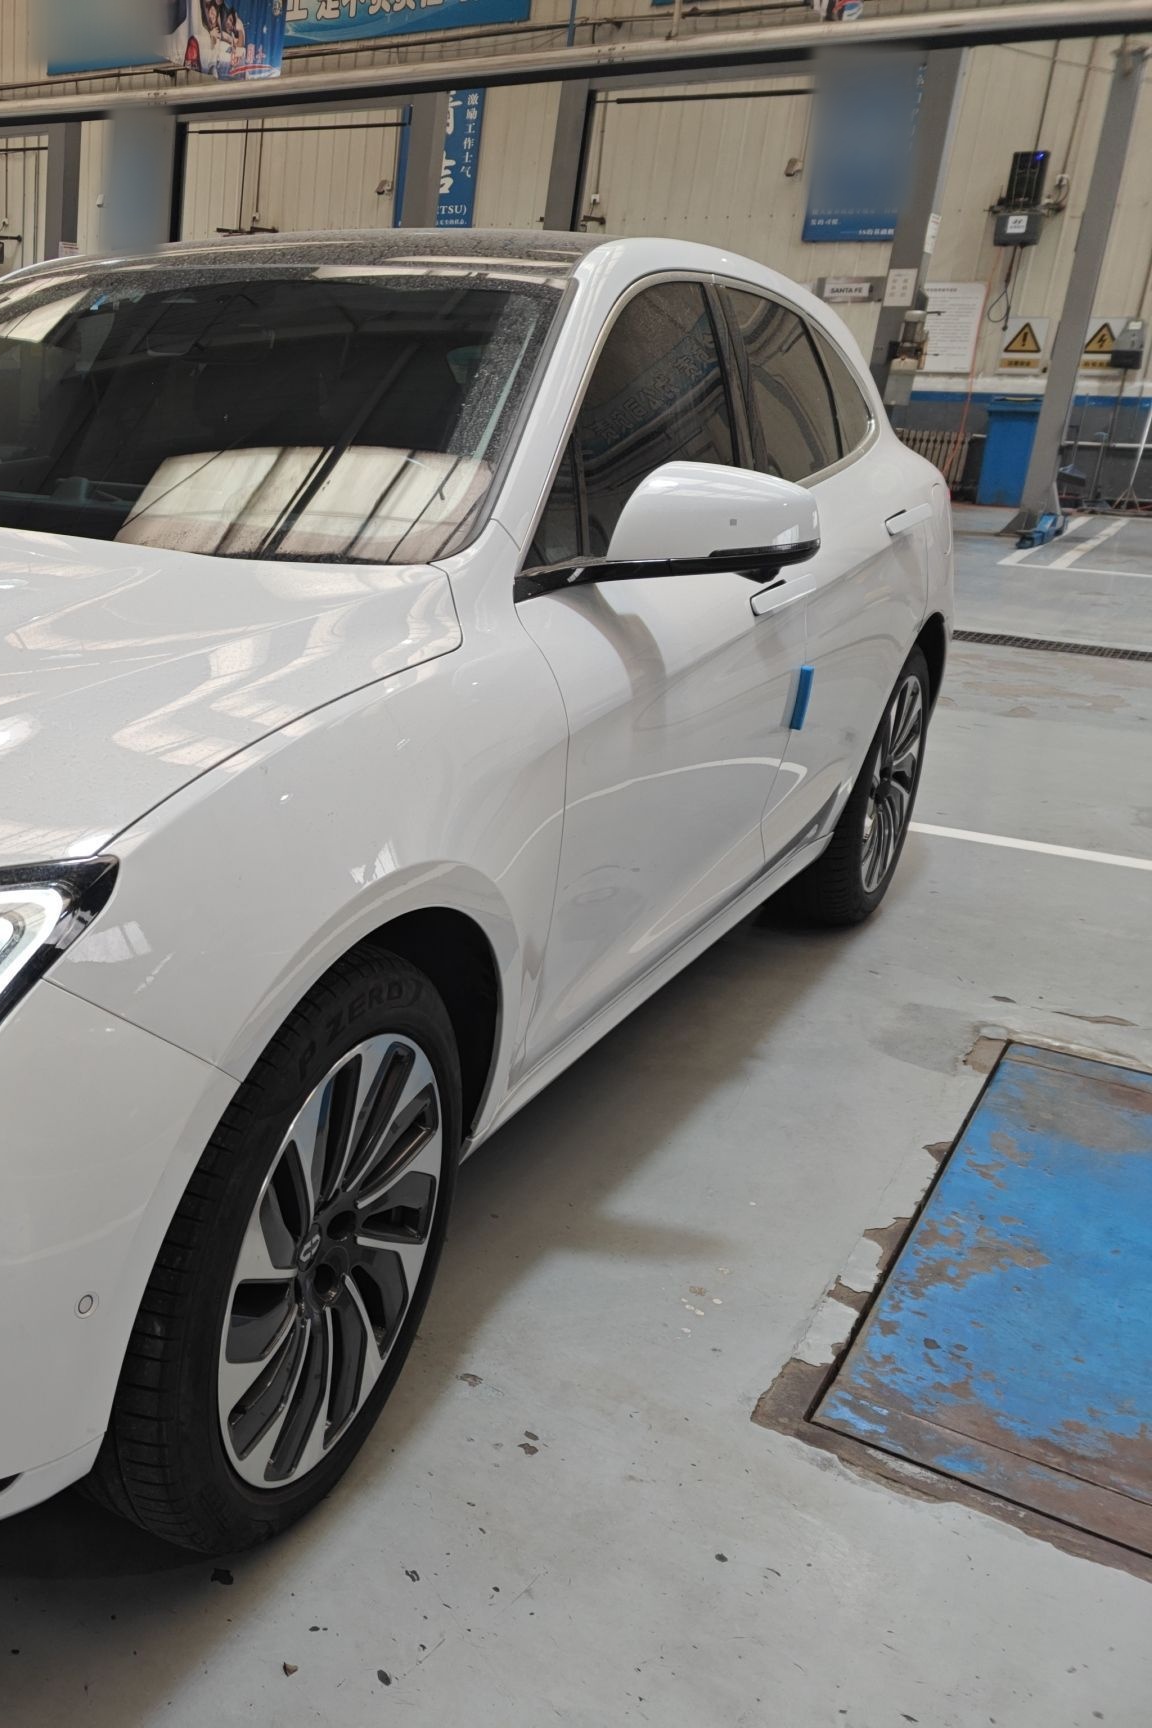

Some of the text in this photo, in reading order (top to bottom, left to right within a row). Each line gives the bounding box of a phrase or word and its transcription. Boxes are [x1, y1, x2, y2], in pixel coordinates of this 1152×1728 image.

[459, 93, 480, 178] 激励工作士气
